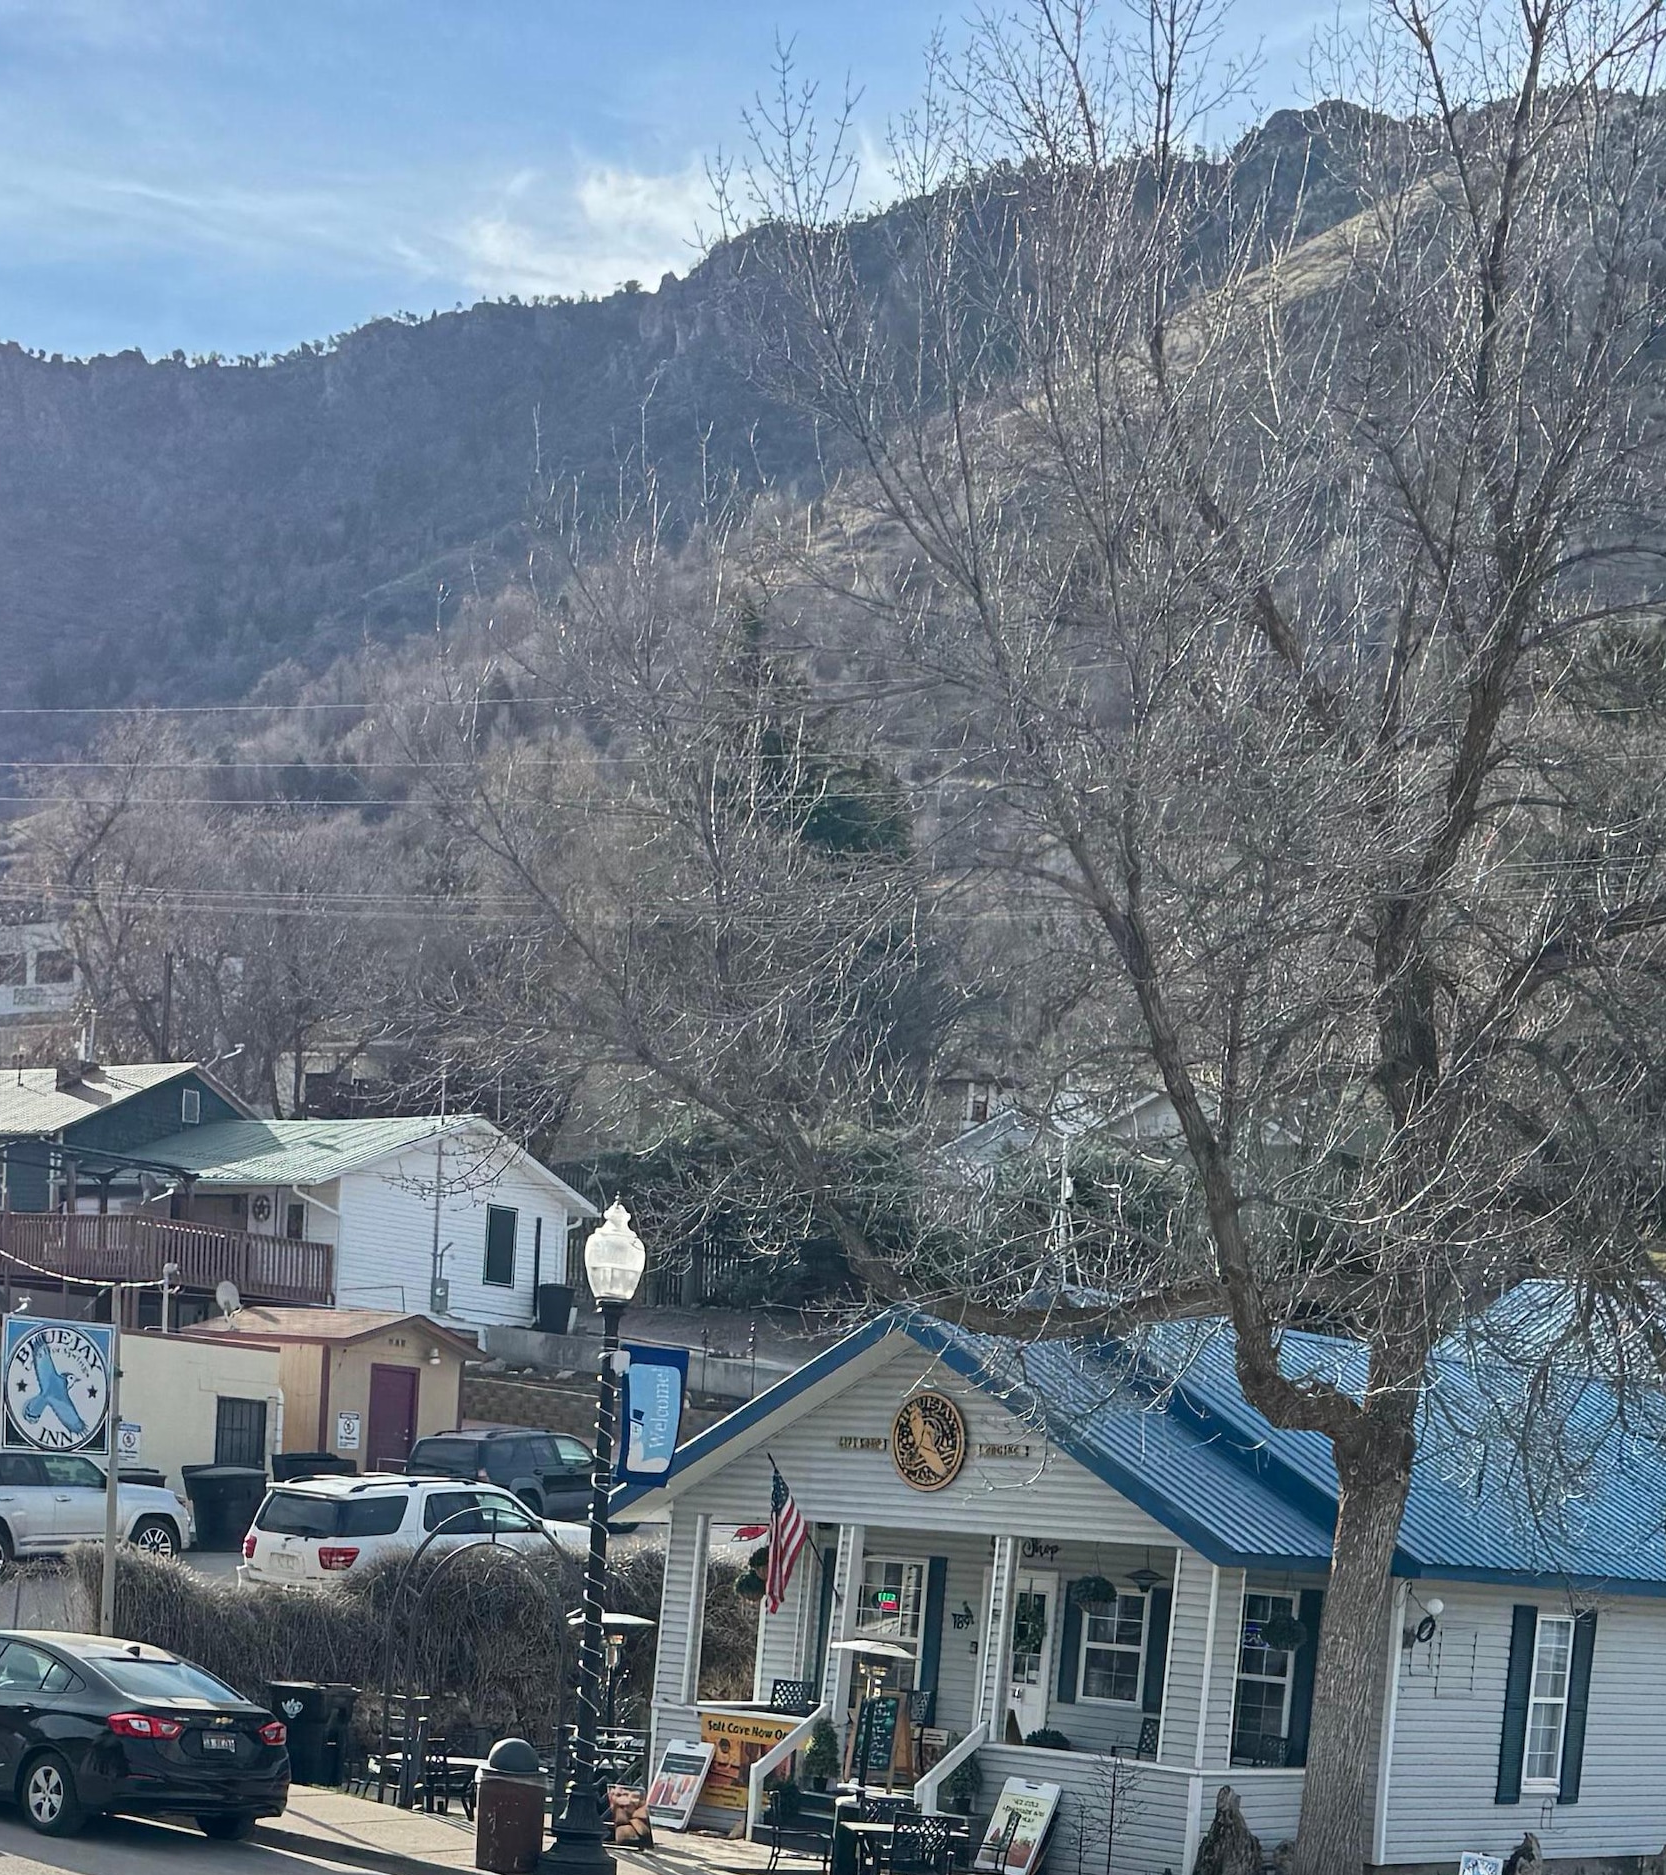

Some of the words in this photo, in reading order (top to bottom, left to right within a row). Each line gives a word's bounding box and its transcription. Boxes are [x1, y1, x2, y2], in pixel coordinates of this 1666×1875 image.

[38, 1427, 74, 1447] INN
[708, 1720, 726, 1732] Salt
[727, 1722, 750, 1735] Cave
[752, 1726, 773, 1739] Now
